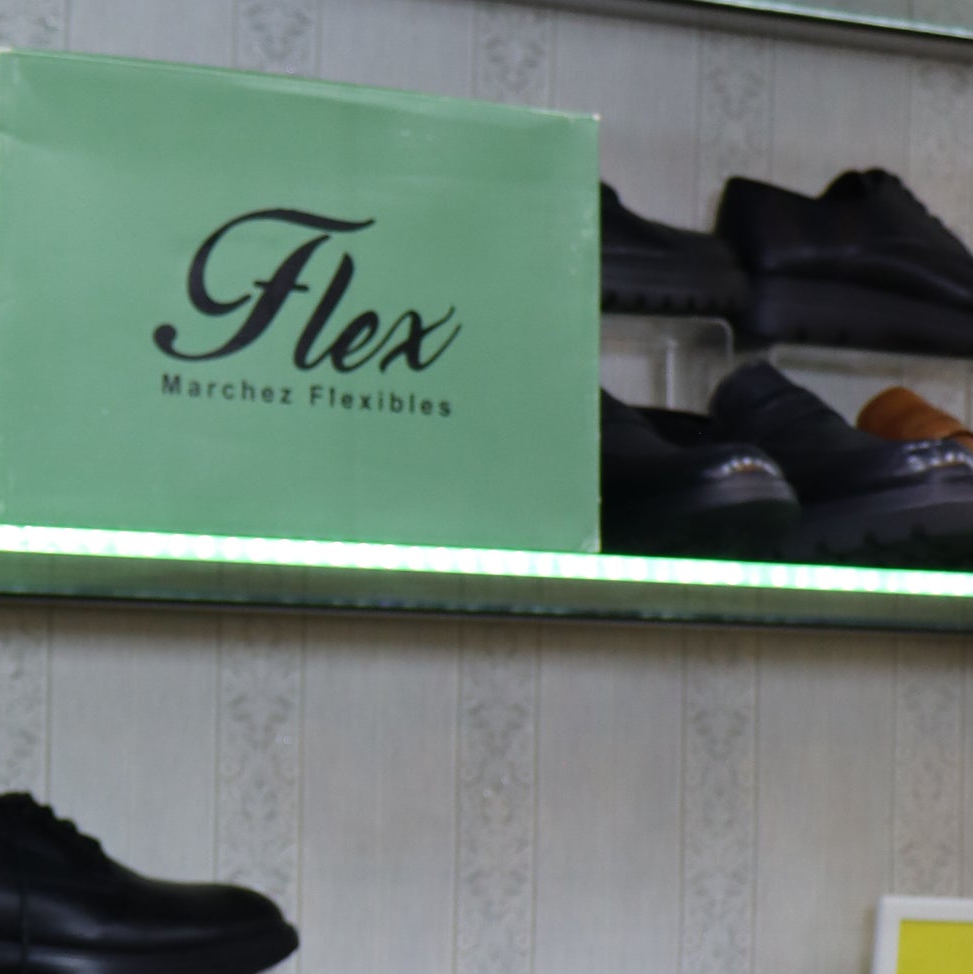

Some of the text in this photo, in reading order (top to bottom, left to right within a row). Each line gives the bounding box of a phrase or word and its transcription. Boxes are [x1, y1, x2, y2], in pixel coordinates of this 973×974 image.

[153, 207, 461, 373] Flex
[161, 373, 452, 417] Marchez Flexibles
